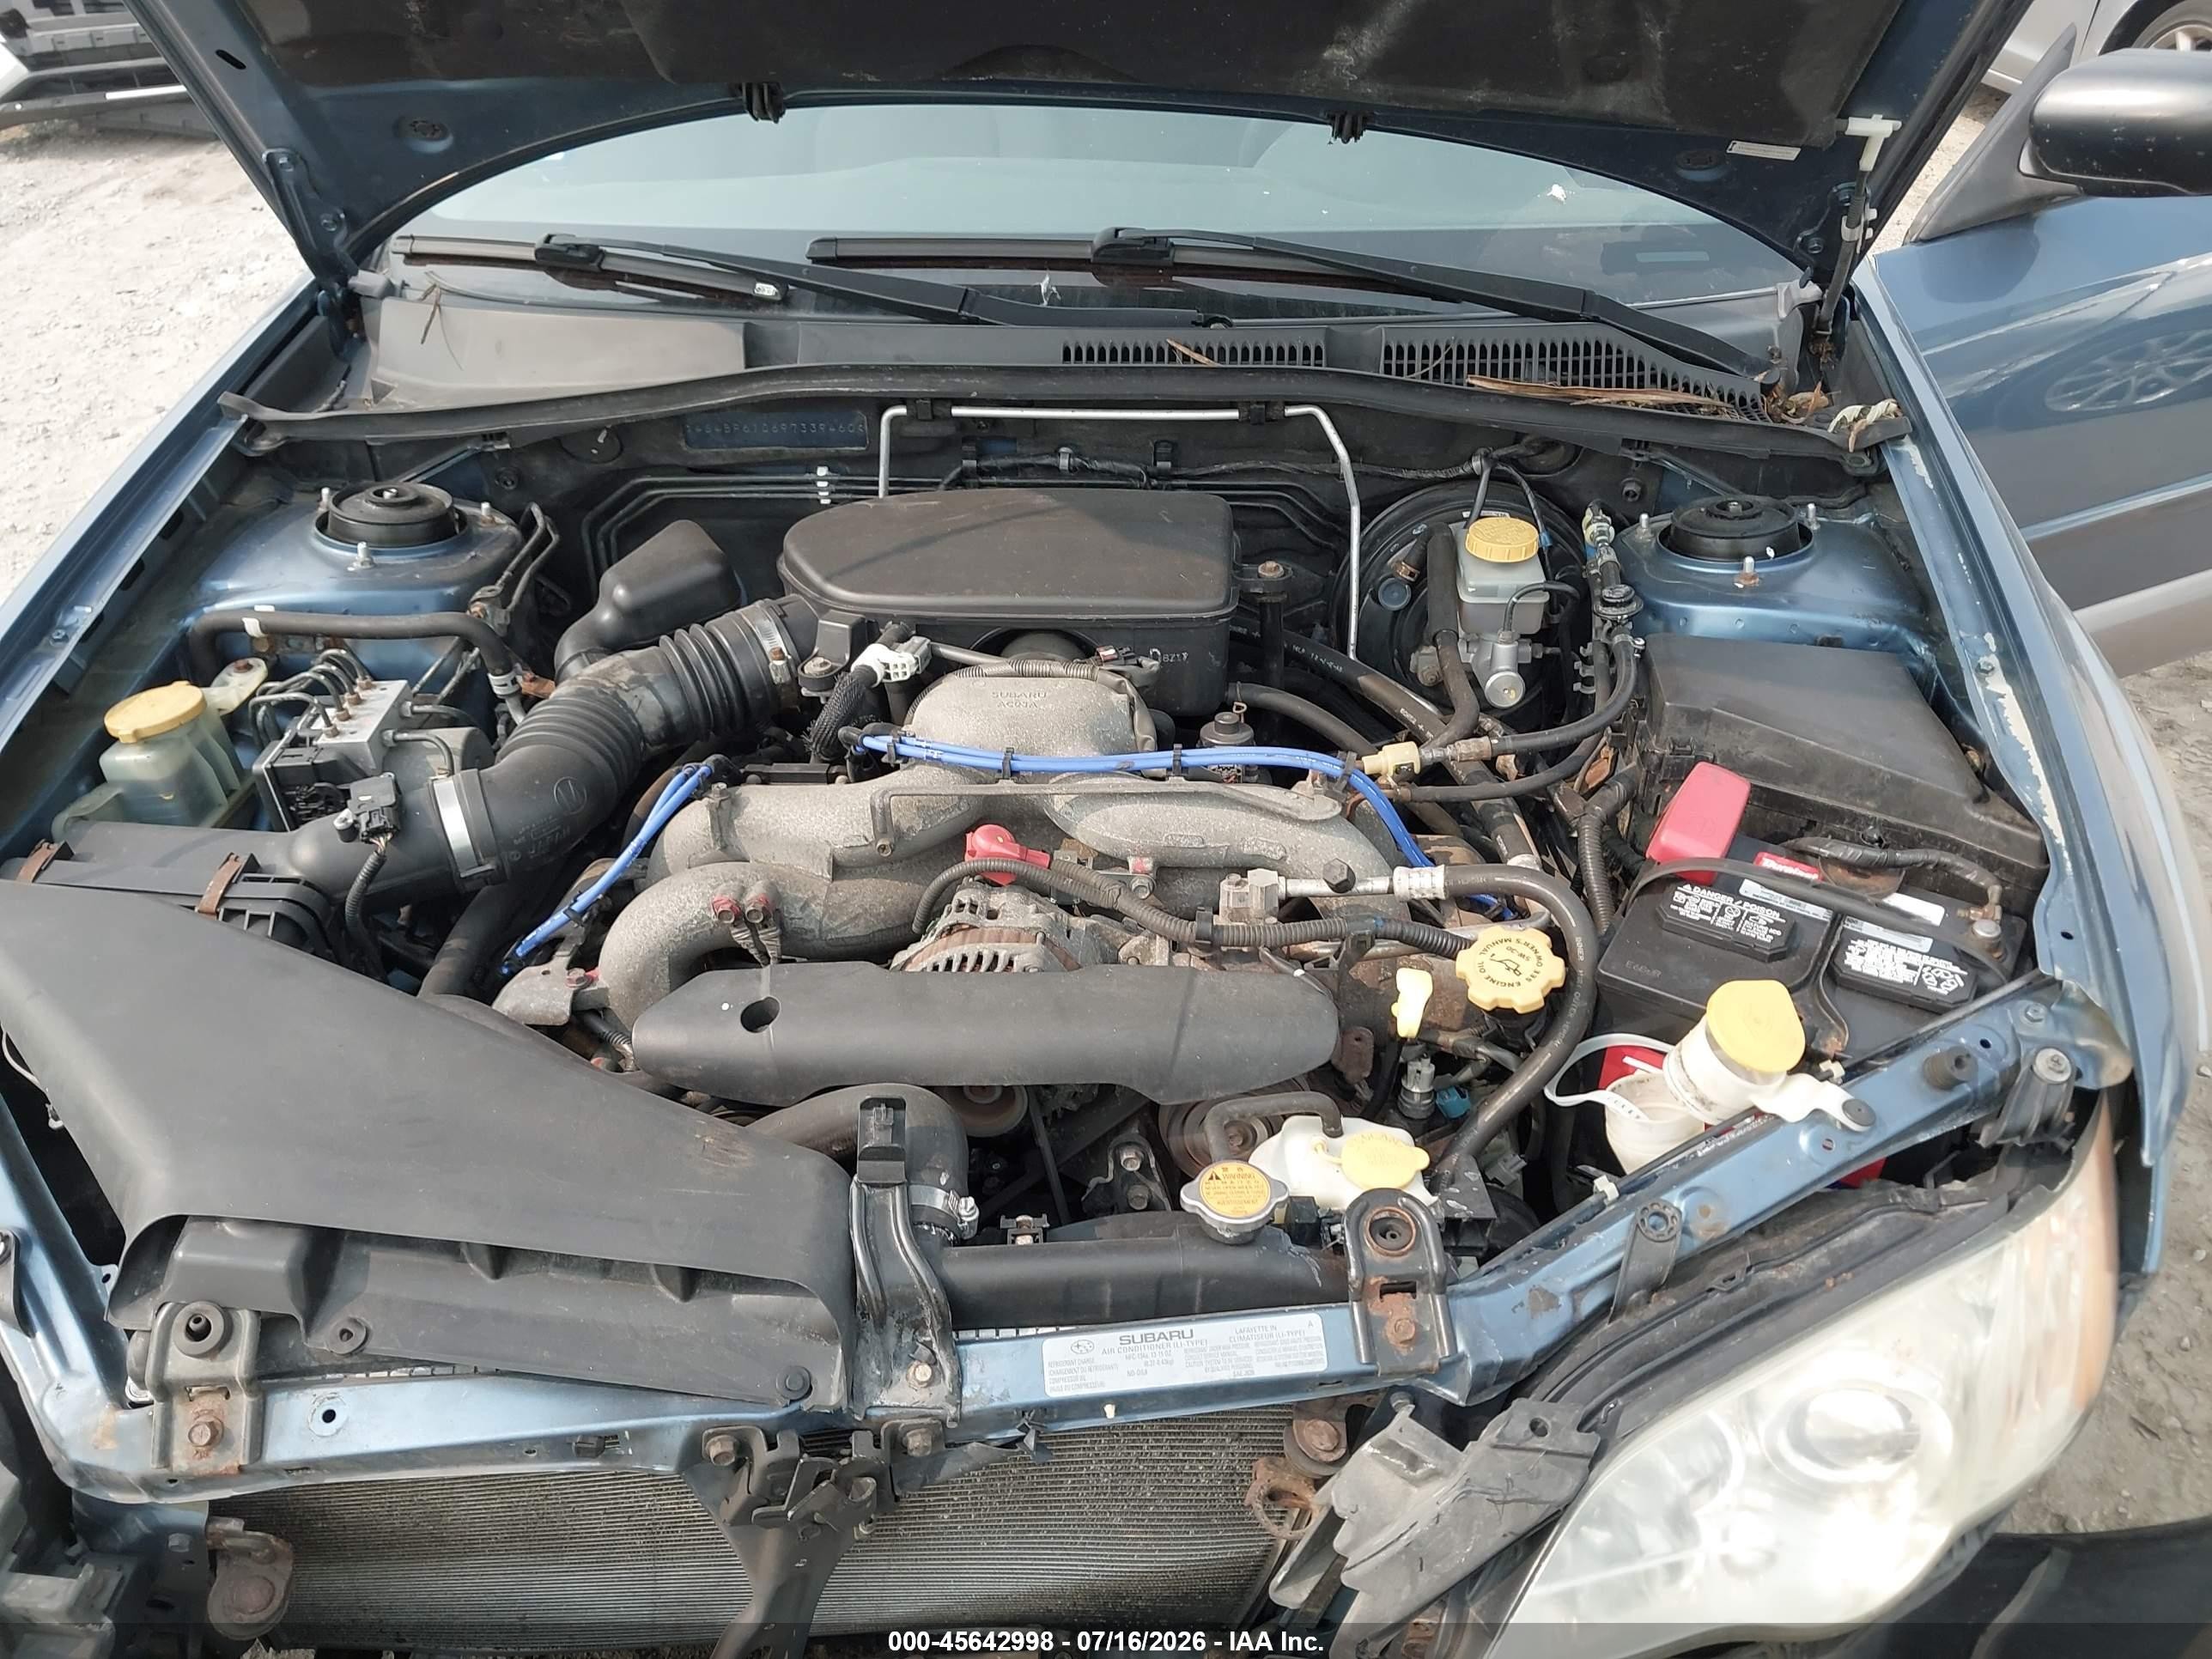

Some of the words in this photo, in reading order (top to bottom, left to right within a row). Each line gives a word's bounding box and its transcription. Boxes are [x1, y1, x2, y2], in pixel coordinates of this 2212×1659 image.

[1692, 885, 1735, 904] DANGER
[1743, 902, 1780, 918] POISON
[1479, 938, 1512, 957] MANUAL
[1477, 960, 1486, 975] OIL
[1485, 974, 1522, 988] ENGINE
[1119, 1328, 1194, 1346] SUBARU
[1229, 1332, 1274, 1343] CLIMATISEUR
[1101, 1346, 1115, 1355] AIR
[1117, 1341, 1172, 1354] CONDITIONER
